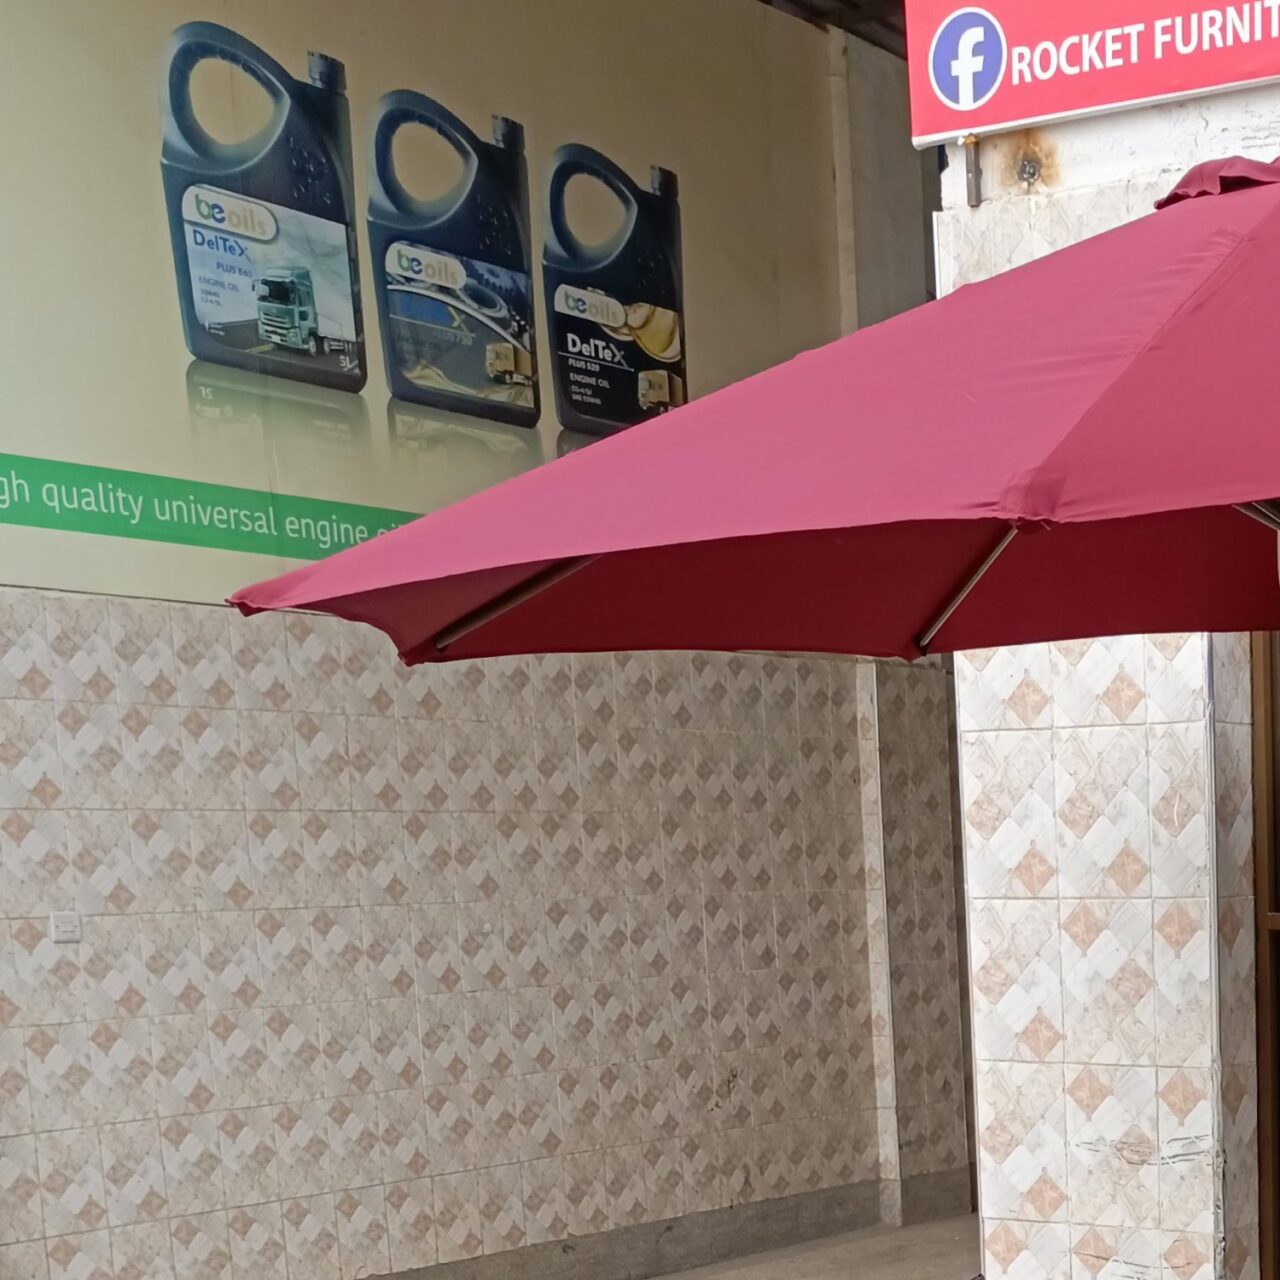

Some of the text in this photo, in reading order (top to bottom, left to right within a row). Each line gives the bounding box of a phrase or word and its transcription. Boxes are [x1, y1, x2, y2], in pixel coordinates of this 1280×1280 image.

[1011, 22, 1145, 86] ROCKET
[42, 482, 143, 525] quality
[154, 494, 278, 536] universal
[285, 514, 368, 549] engine
